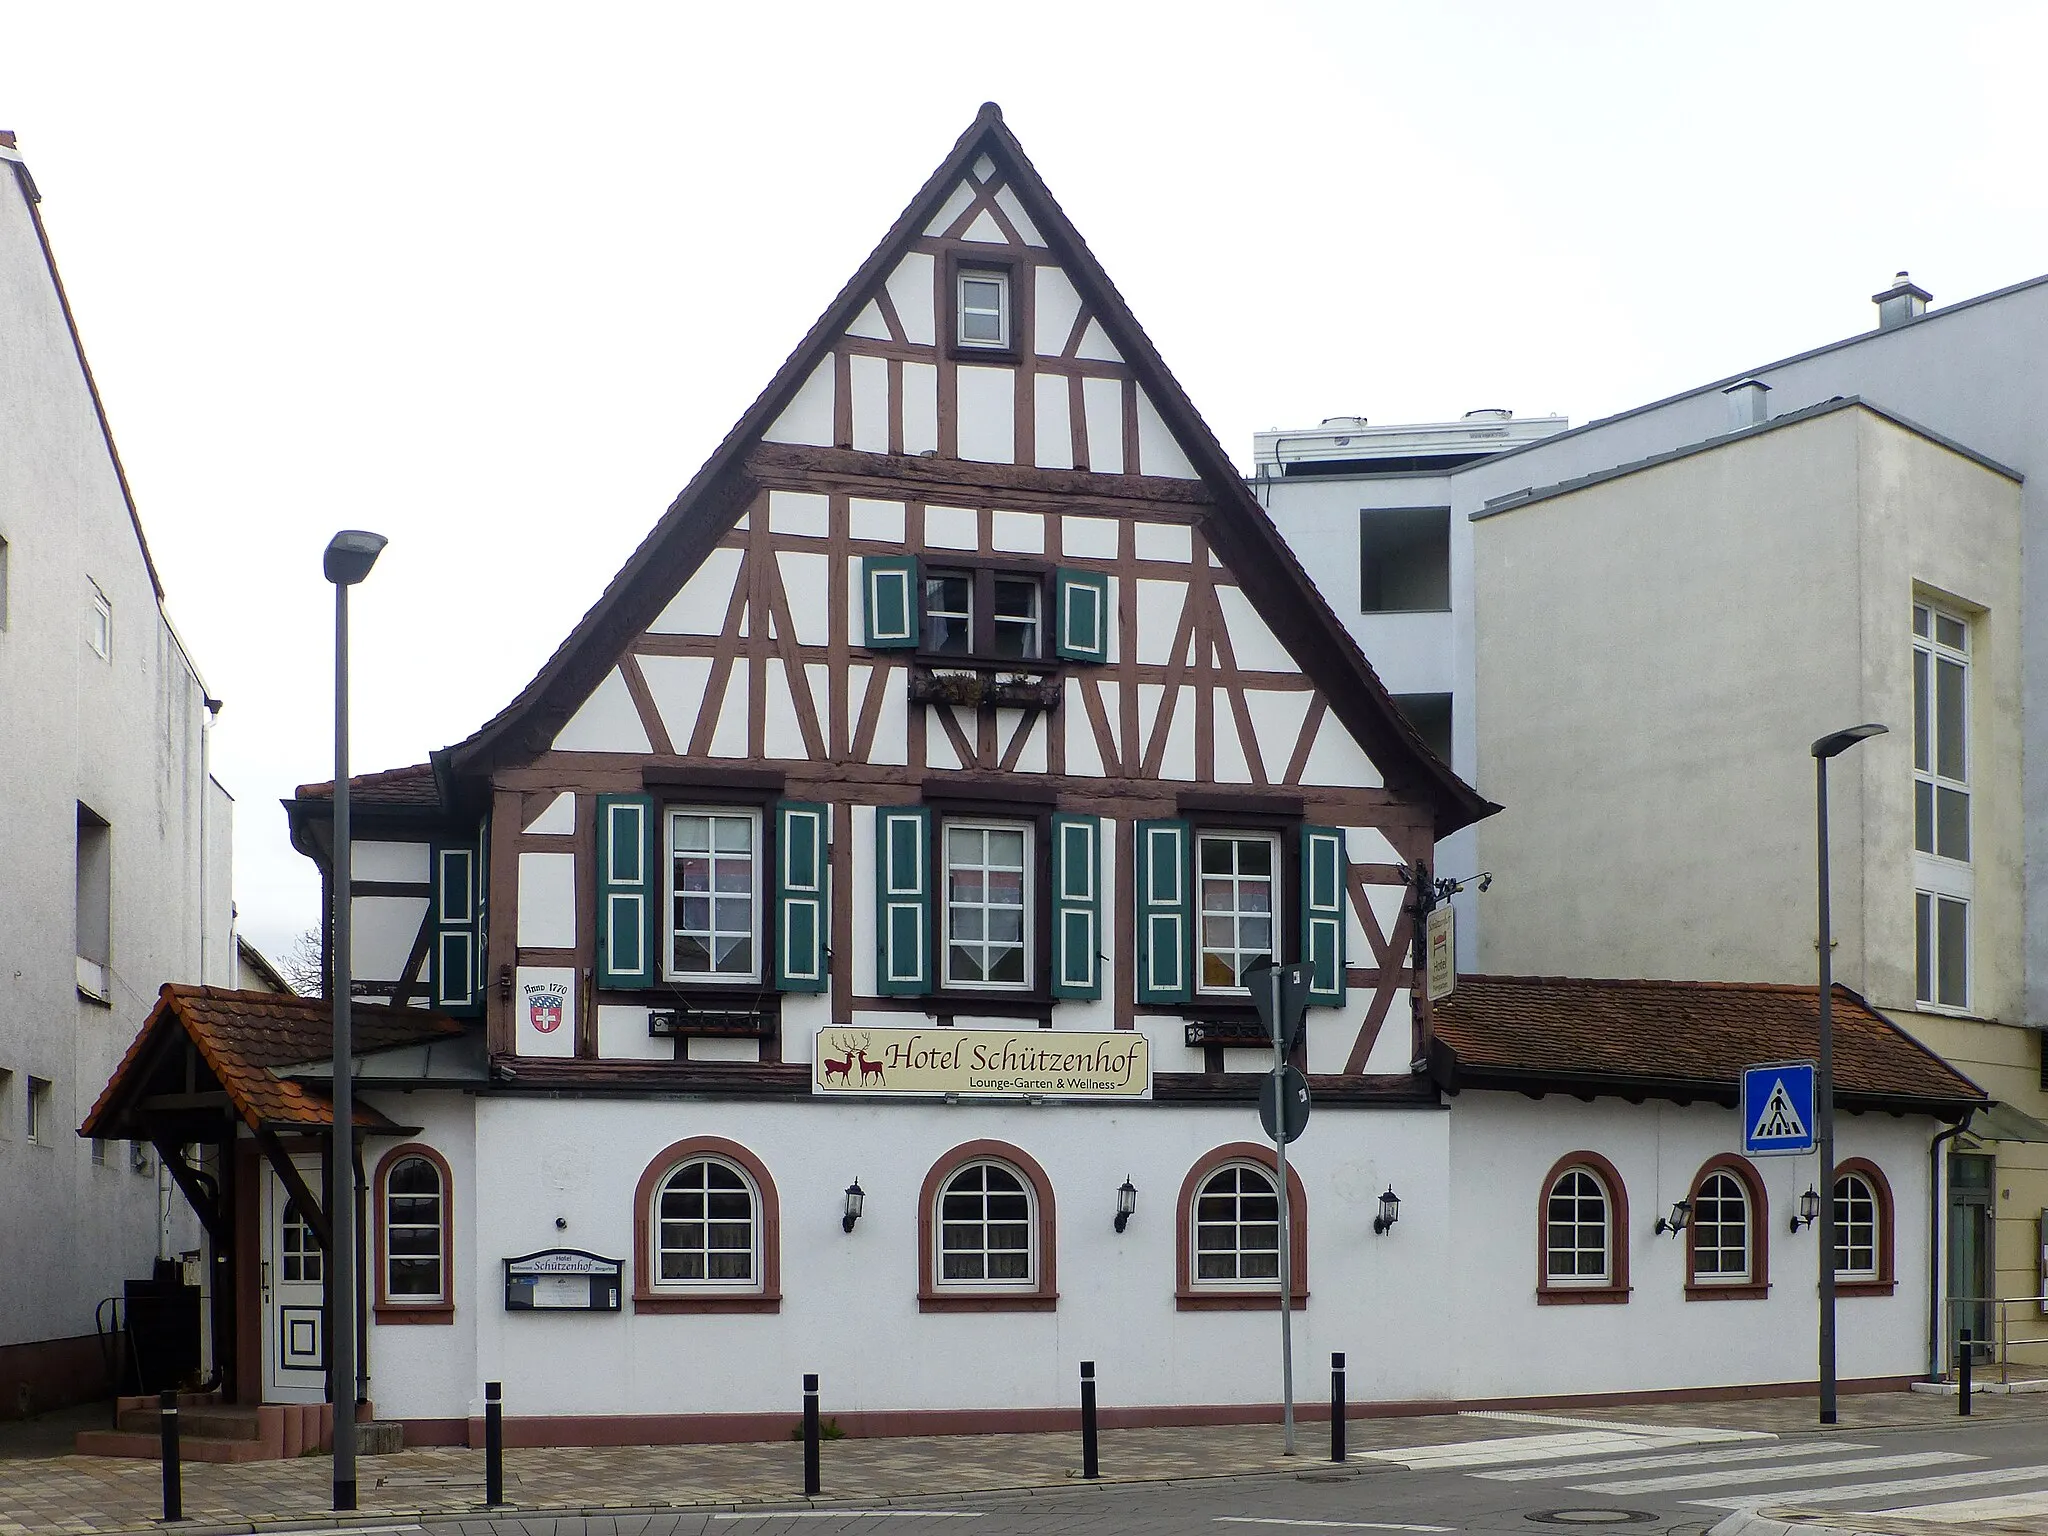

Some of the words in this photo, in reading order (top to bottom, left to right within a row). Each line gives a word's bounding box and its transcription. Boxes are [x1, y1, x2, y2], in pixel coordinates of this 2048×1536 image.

[1433, 959, 1447, 972] Hotel
[549, 983, 568, 994] 1770
[885, 1035, 968, 1070] Hotel
[970, 1038, 1142, 1087] Schützenhof
[969, 1076, 1053, 1090] Lounge-Garten
[1056, 1078, 1065, 1089] &
[1066, 1078, 1115, 1090] Wellness
[534, 1259, 592, 1272] Schützenhof
